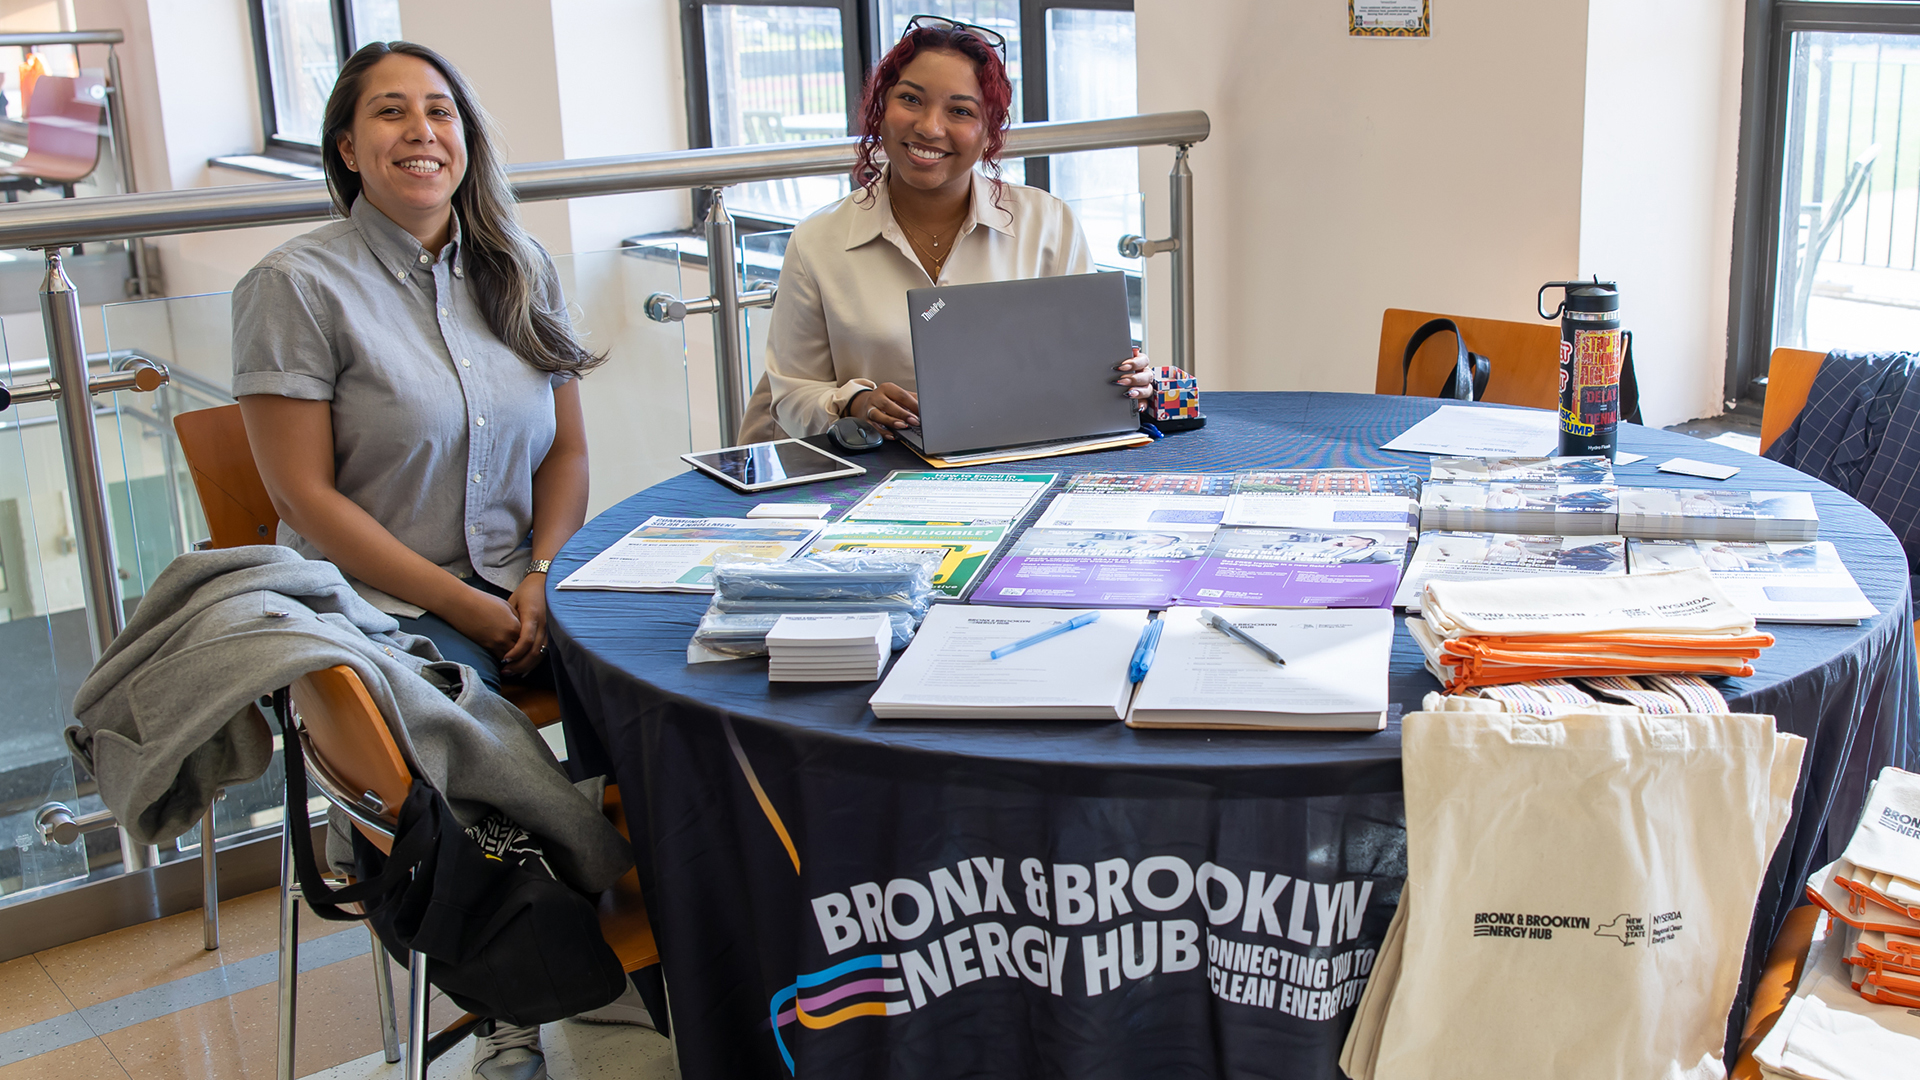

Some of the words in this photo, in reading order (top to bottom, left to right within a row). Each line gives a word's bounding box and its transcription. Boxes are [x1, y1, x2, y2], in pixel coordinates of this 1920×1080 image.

[920, 298, 946, 322] ThinkPad
[1582, 336, 1610, 352] STOP
[1587, 388, 1616, 403] DELAY
[1586, 410, 1616, 426] DENIAL
[1658, 596, 1710, 610] NYSERDA
[1882, 806, 1920, 828] BRON
[811, 856, 1014, 956] BRONX
[1020, 858, 1050, 921] &
[1052, 856, 1374, 948] BROOKLYN
[1474, 912, 1514, 926] BRONX
[1517, 914, 1524, 926] &
[1526, 914, 1590, 929] BROOKLYN
[1653, 911, 1682, 924] NYSERDA
[1530, 928, 1552, 940] HUB
[1653, 927, 1670, 936] Regional
[1652, 936, 1666, 944] Energy
[1082, 920, 1200, 997] HUB
[1332, 950, 1353, 986] YOU
[1354, 948, 1376, 978] TO
[1210, 964, 1276, 1010] CLEAN
[1279, 982, 1343, 1022] ENERGY
[1340, 978, 1370, 1011] FUT
